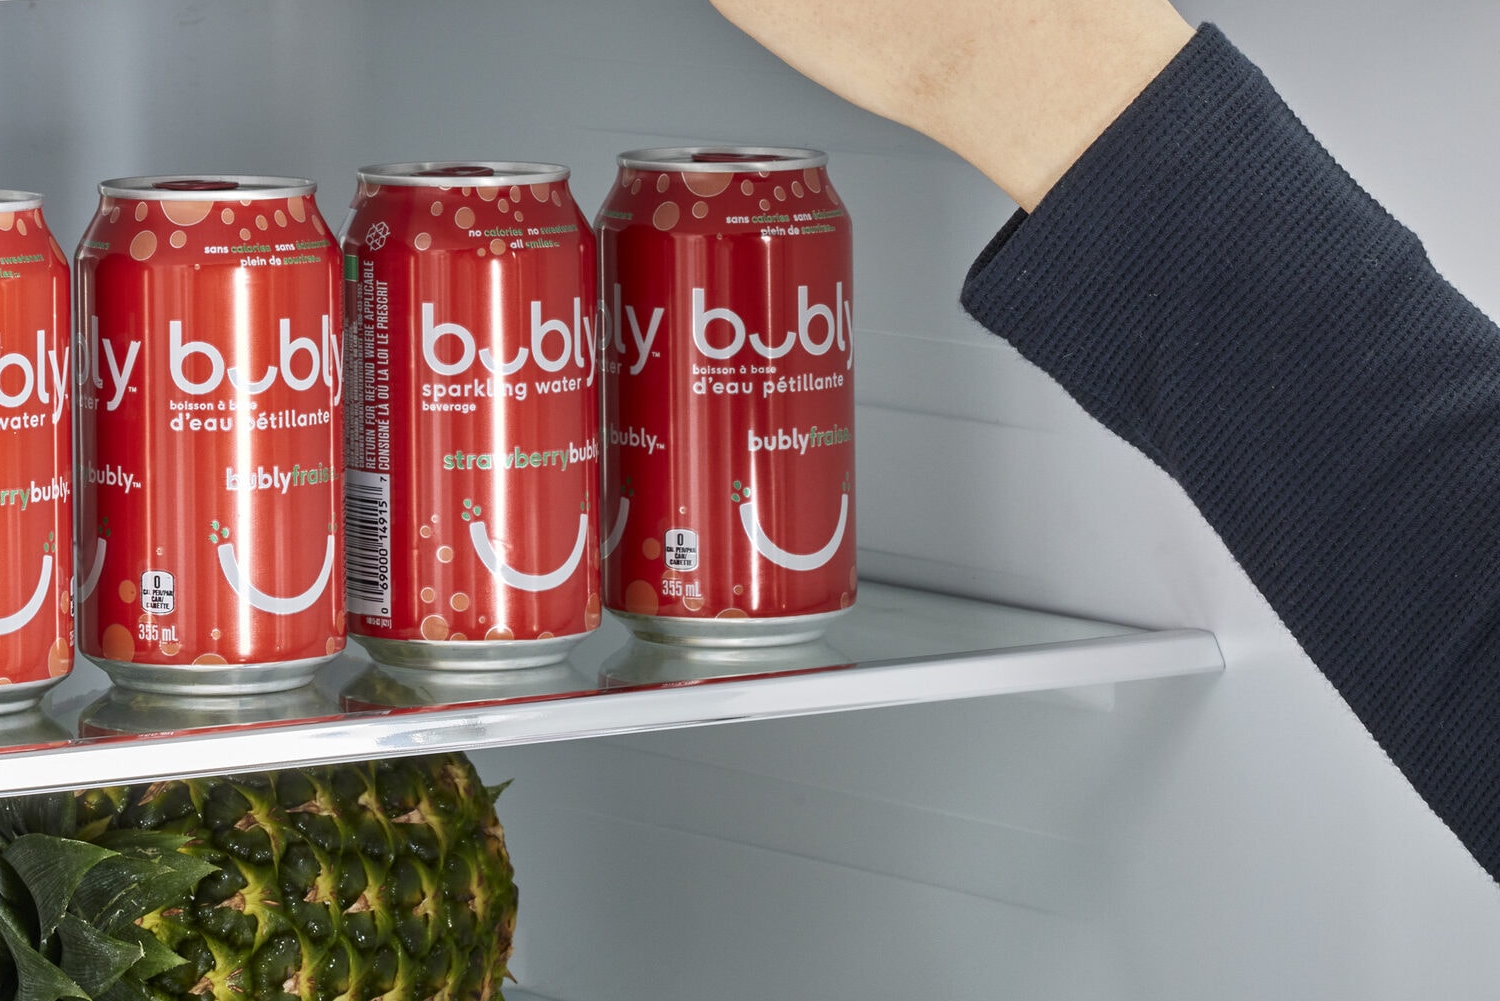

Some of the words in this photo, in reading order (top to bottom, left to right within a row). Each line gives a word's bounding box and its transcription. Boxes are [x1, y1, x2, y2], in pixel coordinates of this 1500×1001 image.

[725, 216, 749, 224] sans
[793, 213, 812, 222] sans
[468, 229, 481, 237] no
[527, 227, 539, 236] no
[760, 226, 786, 237] plein
[788, 226, 800, 236] de
[204, 246, 229, 254] sans
[275, 243, 296, 252] sans
[510, 239, 523, 249] all
[240, 256, 267, 268] plein
[269, 256, 282, 266] de
[364, 260, 374, 321] APPLICABLE
[376, 280, 388, 329] PRESCRIT
[364, 324, 375, 358] WHERE
[378, 333, 388, 344] LE
[378, 348, 388, 365] LOI
[378, 369, 388, 381] LA
[692, 364, 735, 375] boisson
[739, 365, 747, 374] à
[751, 365, 777, 375] base
[365, 363, 375, 401] REFUND
[536, 377, 581, 394] water
[692, 378, 753, 395] d'eau
[763, 373, 844, 398] pétillante
[376, 384, 388, 399] OÙ
[169, 400, 214, 411] boisson
[217, 400, 225, 410] à
[376, 403, 389, 416] LÀ
[422, 401, 476, 413] beverage
[169, 414, 232, 431] d'eau
[365, 406, 375, 425] FOR
[365, 429, 376, 469] RETURN
[376, 419, 389, 470] CONSIGNÉ
[378, 500, 387, 540] 14915
[677, 533, 684, 546] 0
[379, 548, 388, 590] 69000
[154, 575, 161, 589] 0
[662, 580, 683, 596] 355
[685, 581, 702, 597] mL
[138, 623, 159, 640] 355
[161, 625, 179, 641] mL
